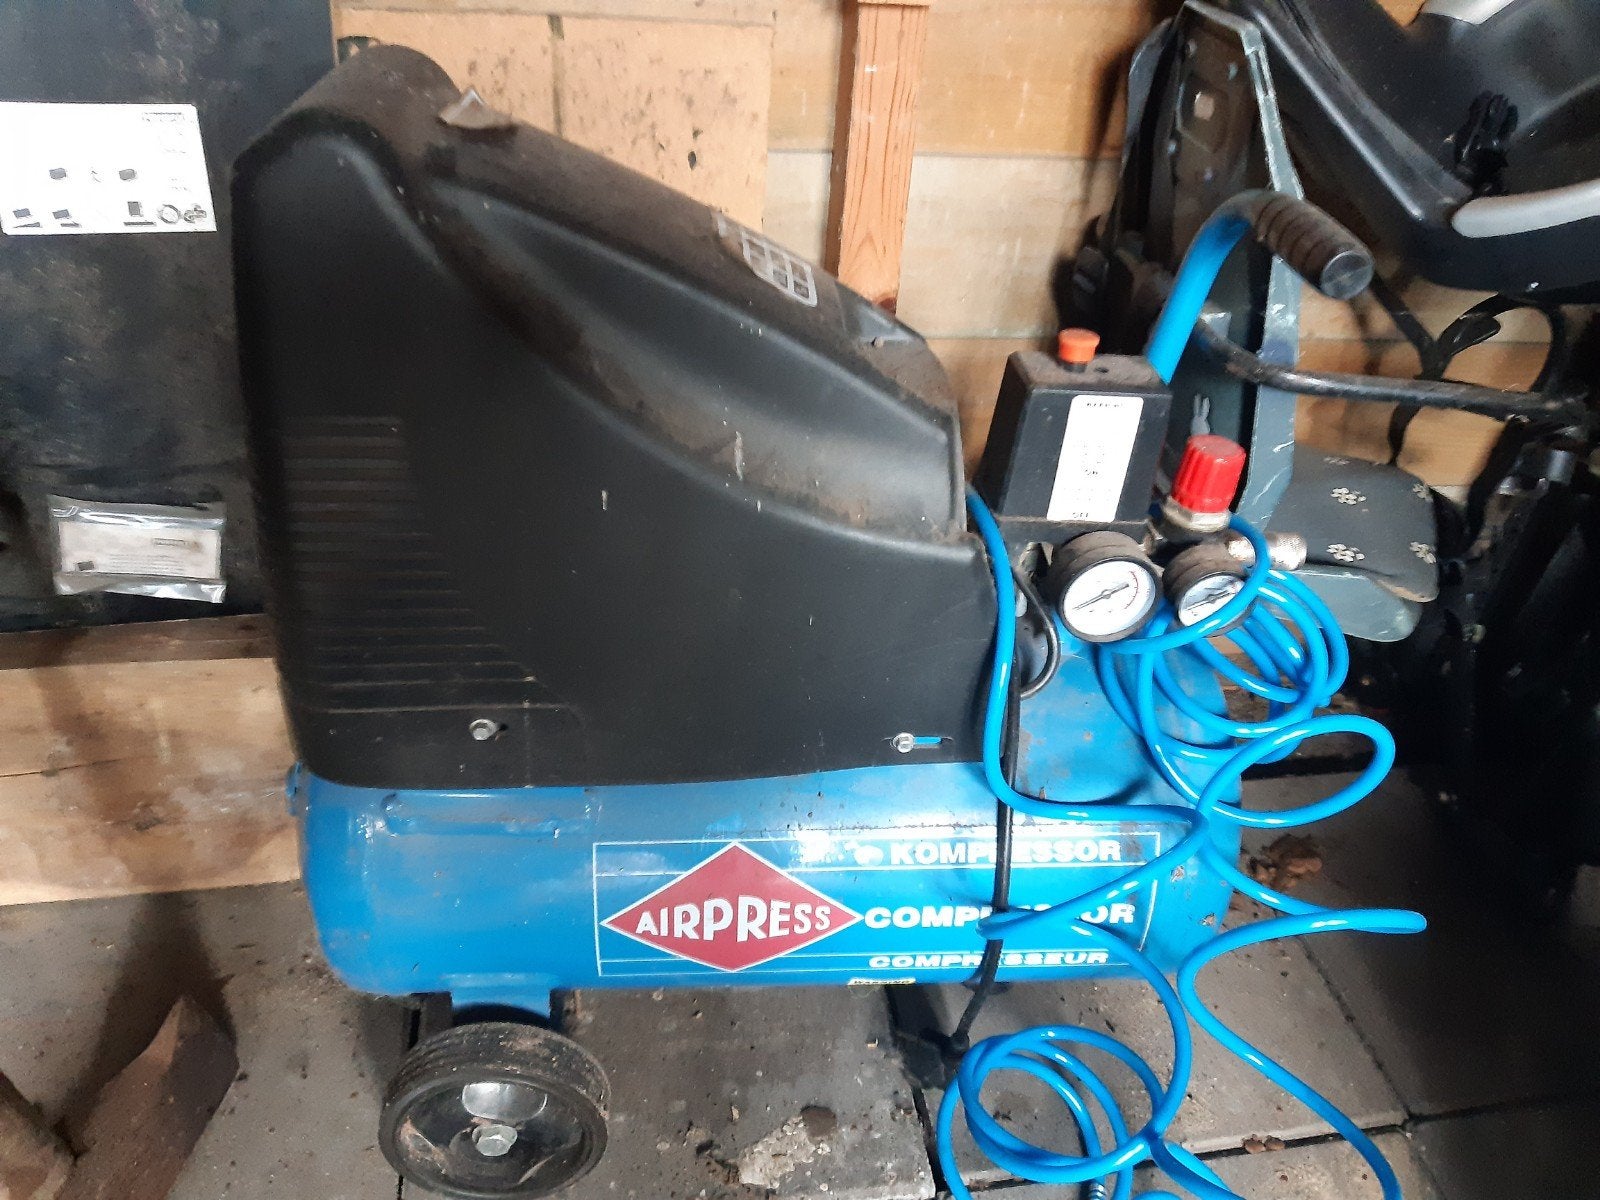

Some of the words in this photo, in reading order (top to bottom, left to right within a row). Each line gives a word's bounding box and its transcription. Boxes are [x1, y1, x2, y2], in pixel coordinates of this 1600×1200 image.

[890, 839, 1121, 866] KOMPESSOR
[635, 894, 831, 942] AIRPRESS
[864, 903, 1136, 929] COMPOR
[869, 952, 1108, 968] COMPRSSEUR
